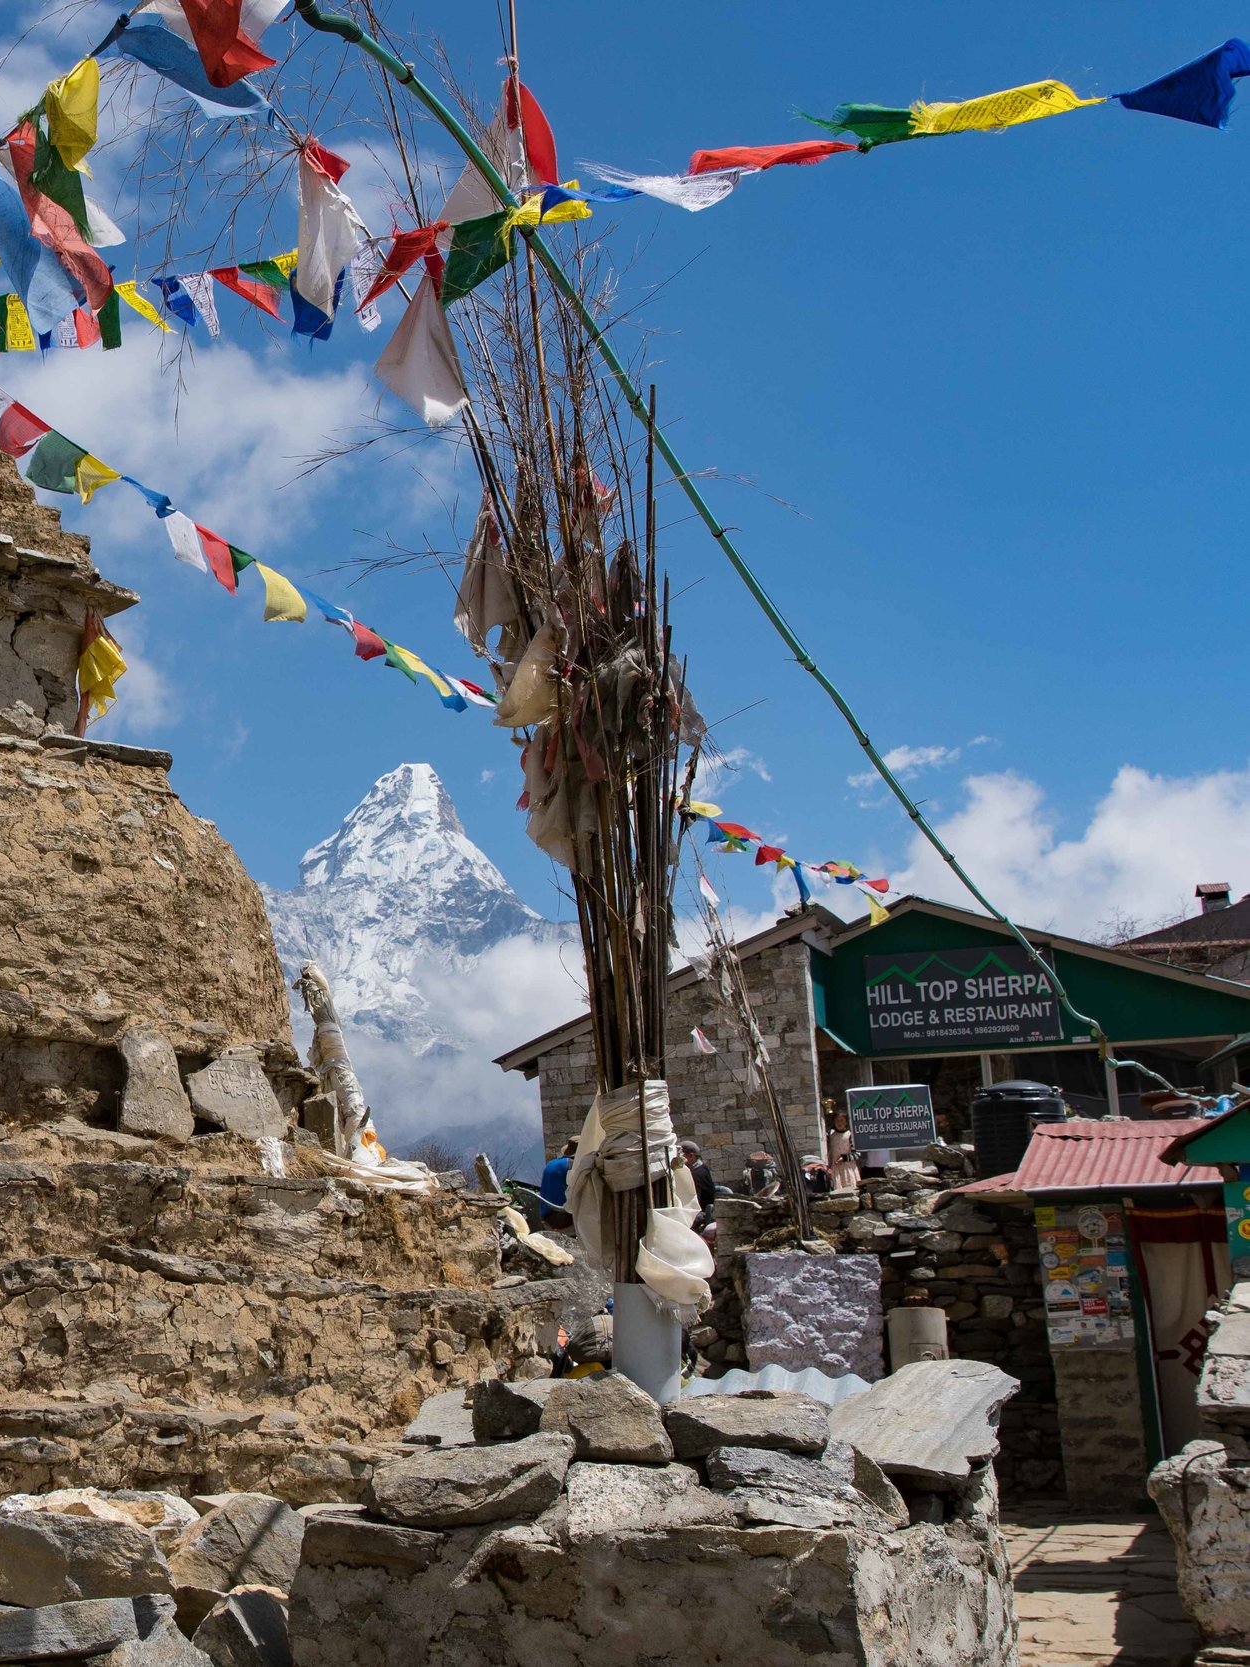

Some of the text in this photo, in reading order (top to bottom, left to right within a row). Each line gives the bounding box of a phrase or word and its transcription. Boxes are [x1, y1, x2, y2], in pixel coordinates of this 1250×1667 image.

[866, 973, 1053, 1006] HILL TOP SHERPA
[869, 1001, 1053, 1029] LODGE & RESTAURANT
[852, 1104, 931, 1121] HILL TOP SHERPA
[854, 1120, 931, 1134] LODGE & RESTAURANT
